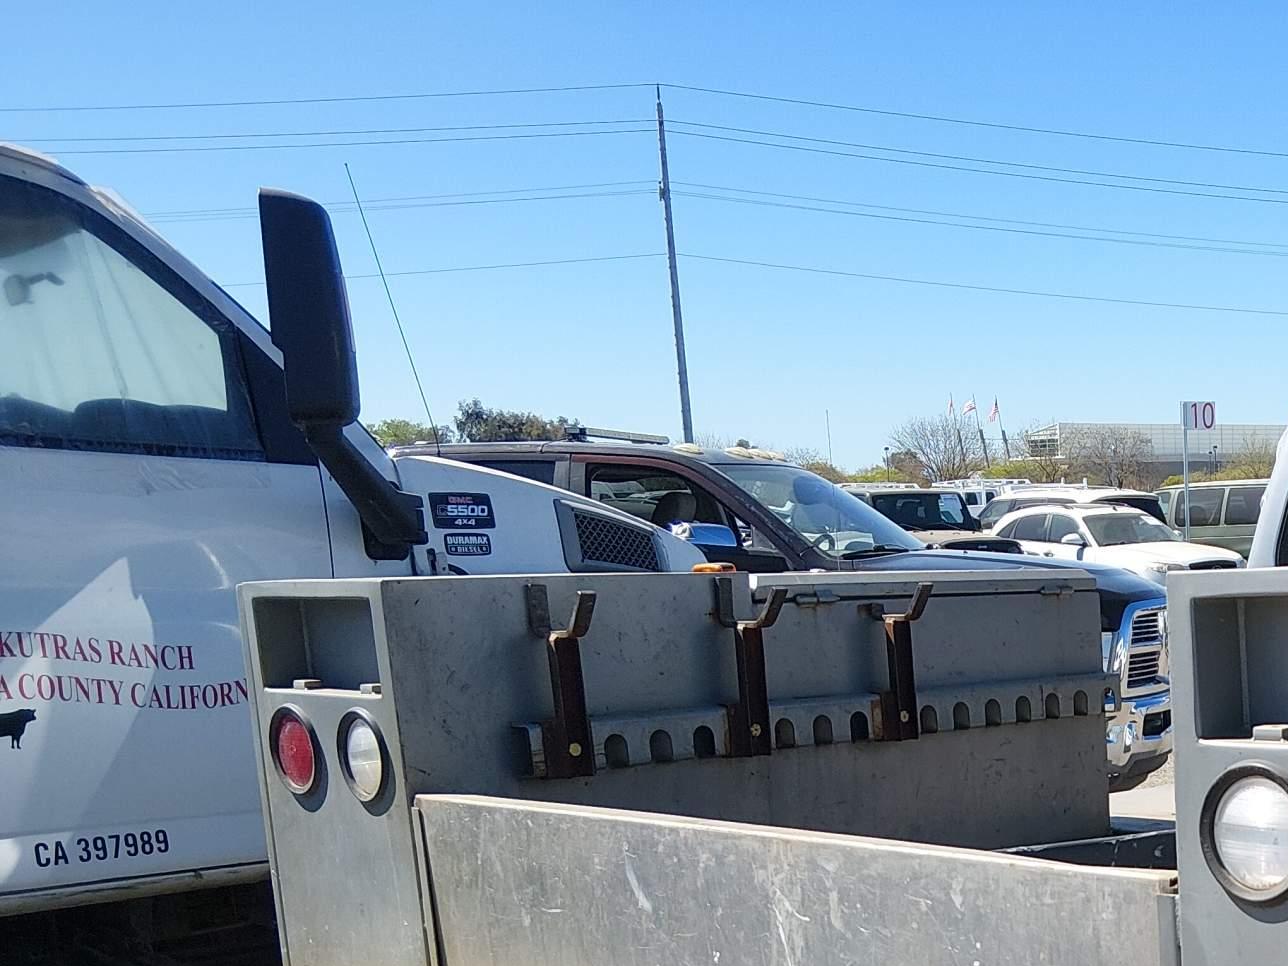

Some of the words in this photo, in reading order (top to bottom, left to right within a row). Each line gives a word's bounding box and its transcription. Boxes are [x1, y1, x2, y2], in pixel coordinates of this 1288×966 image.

[1190, 402, 1215, 429] 10
[436, 504, 489, 517] C5500
[447, 495, 474, 504] GMC
[446, 535, 489, 545] DURAMAX
[0, 631, 101, 664] KUTRAS
[107, 639, 195, 670] RANCH
[18, 673, 123, 705] COUNTY
[34, 840, 69, 868] CA
[76, 829, 170, 863] 397989
